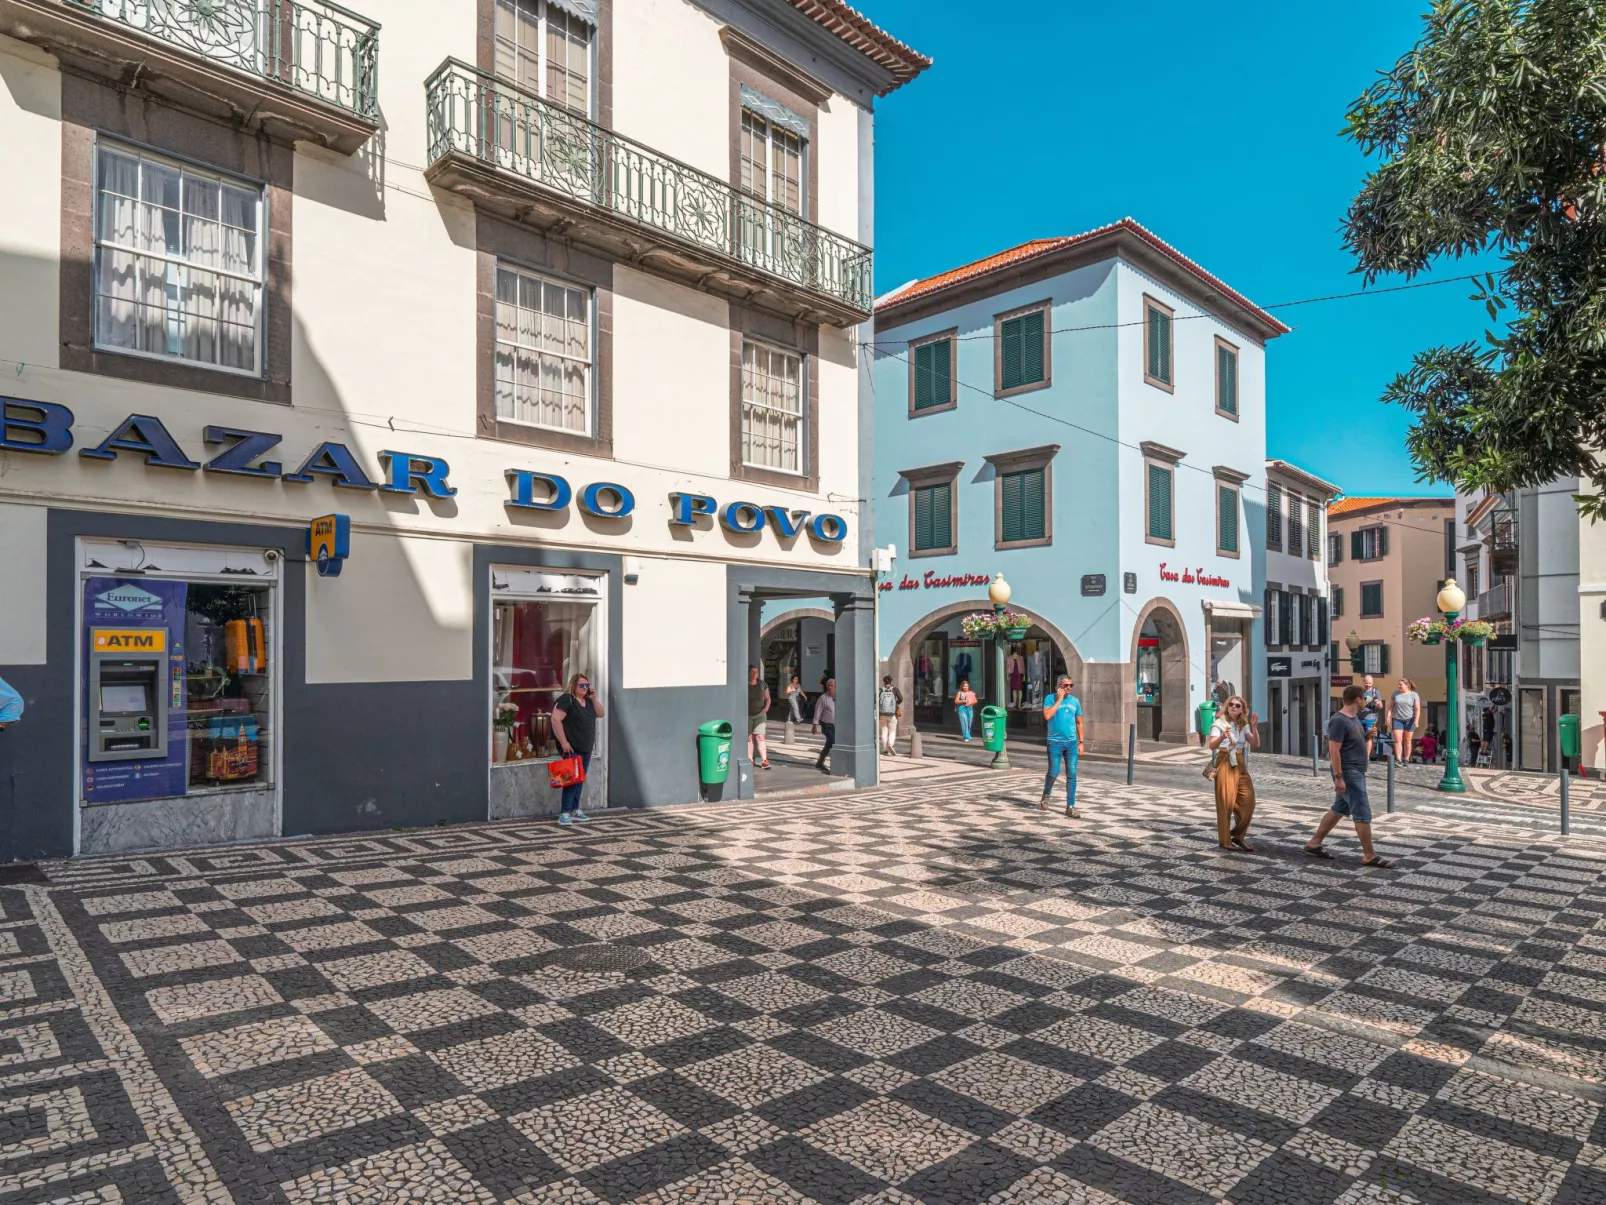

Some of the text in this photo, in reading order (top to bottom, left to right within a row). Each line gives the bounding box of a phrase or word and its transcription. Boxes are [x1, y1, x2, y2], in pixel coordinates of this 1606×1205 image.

[0, 395, 848, 543] BAZAR DO POVO
[315, 520, 333, 536] ATM
[899, 573, 920, 590] das
[923, 570, 990, 589] Casimiras
[1159, 562, 1179, 582] Casa
[1181, 567, 1195, 584] das
[107, 592, 152, 603] Euronet
[107, 635, 154, 647] ATM
